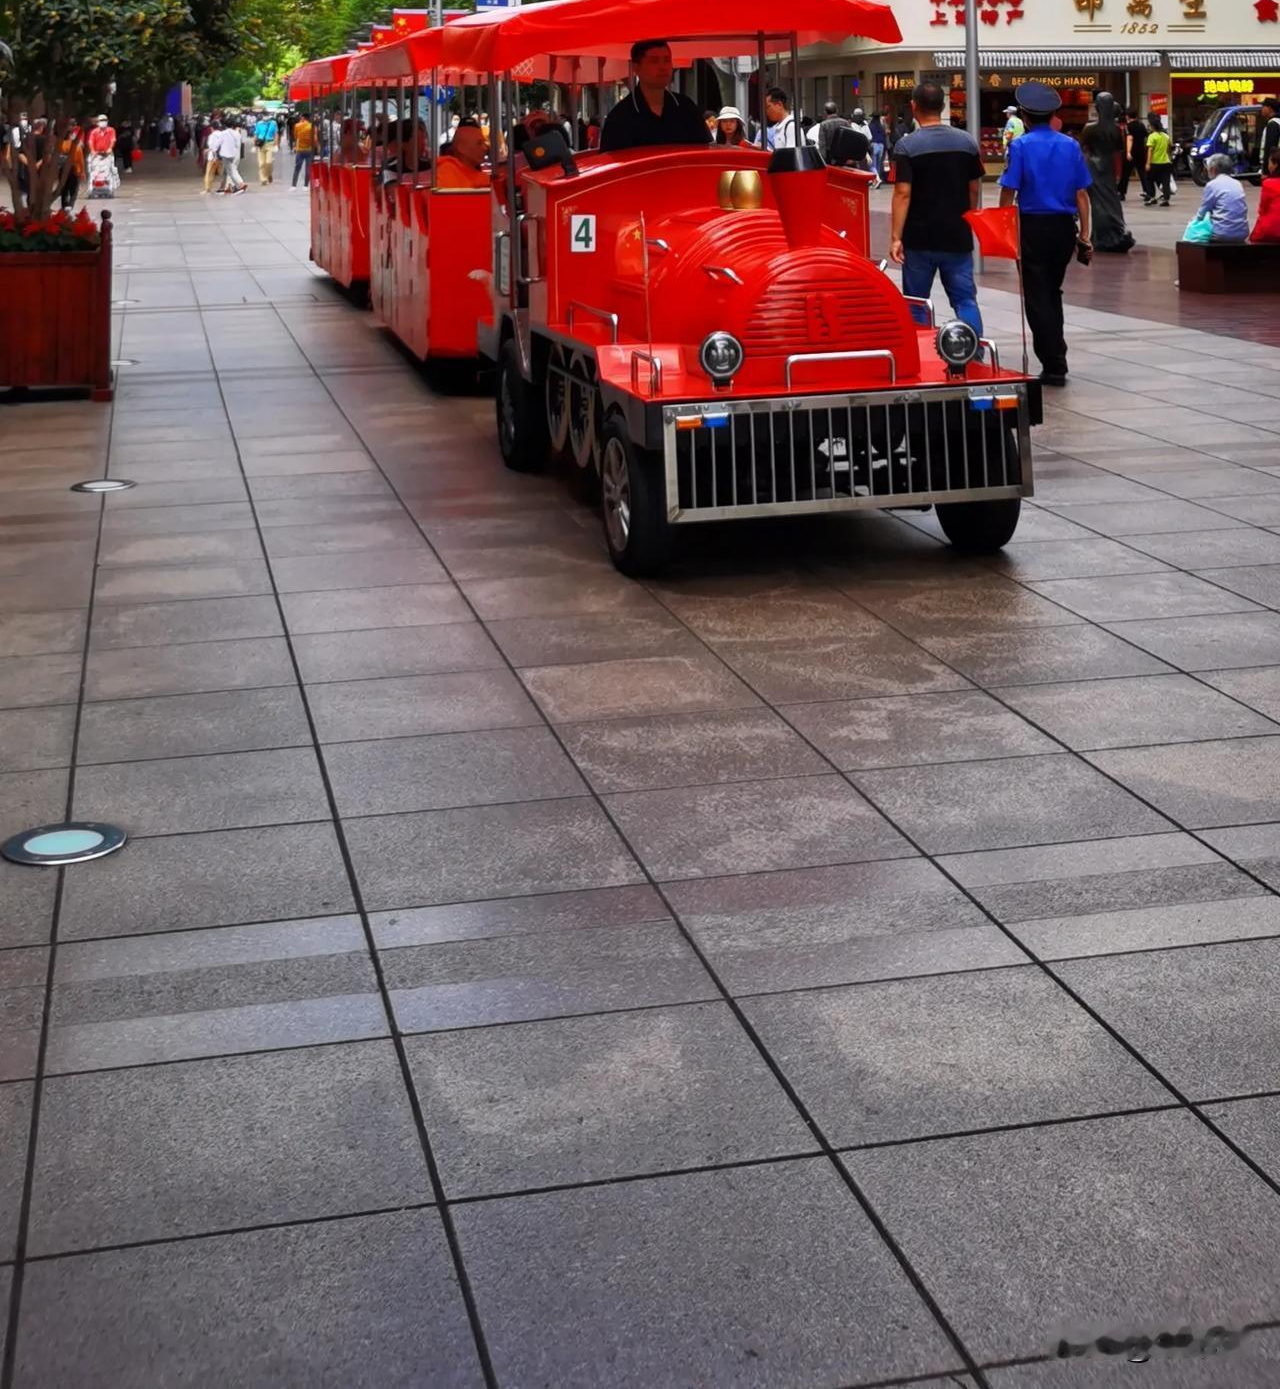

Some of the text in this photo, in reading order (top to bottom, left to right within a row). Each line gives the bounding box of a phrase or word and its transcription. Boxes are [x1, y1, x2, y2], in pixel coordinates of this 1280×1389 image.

[1120, 22, 1159, 35] 1852
[1063, 76, 1096, 86] HIANG
[574, 218, 593, 249] 4
